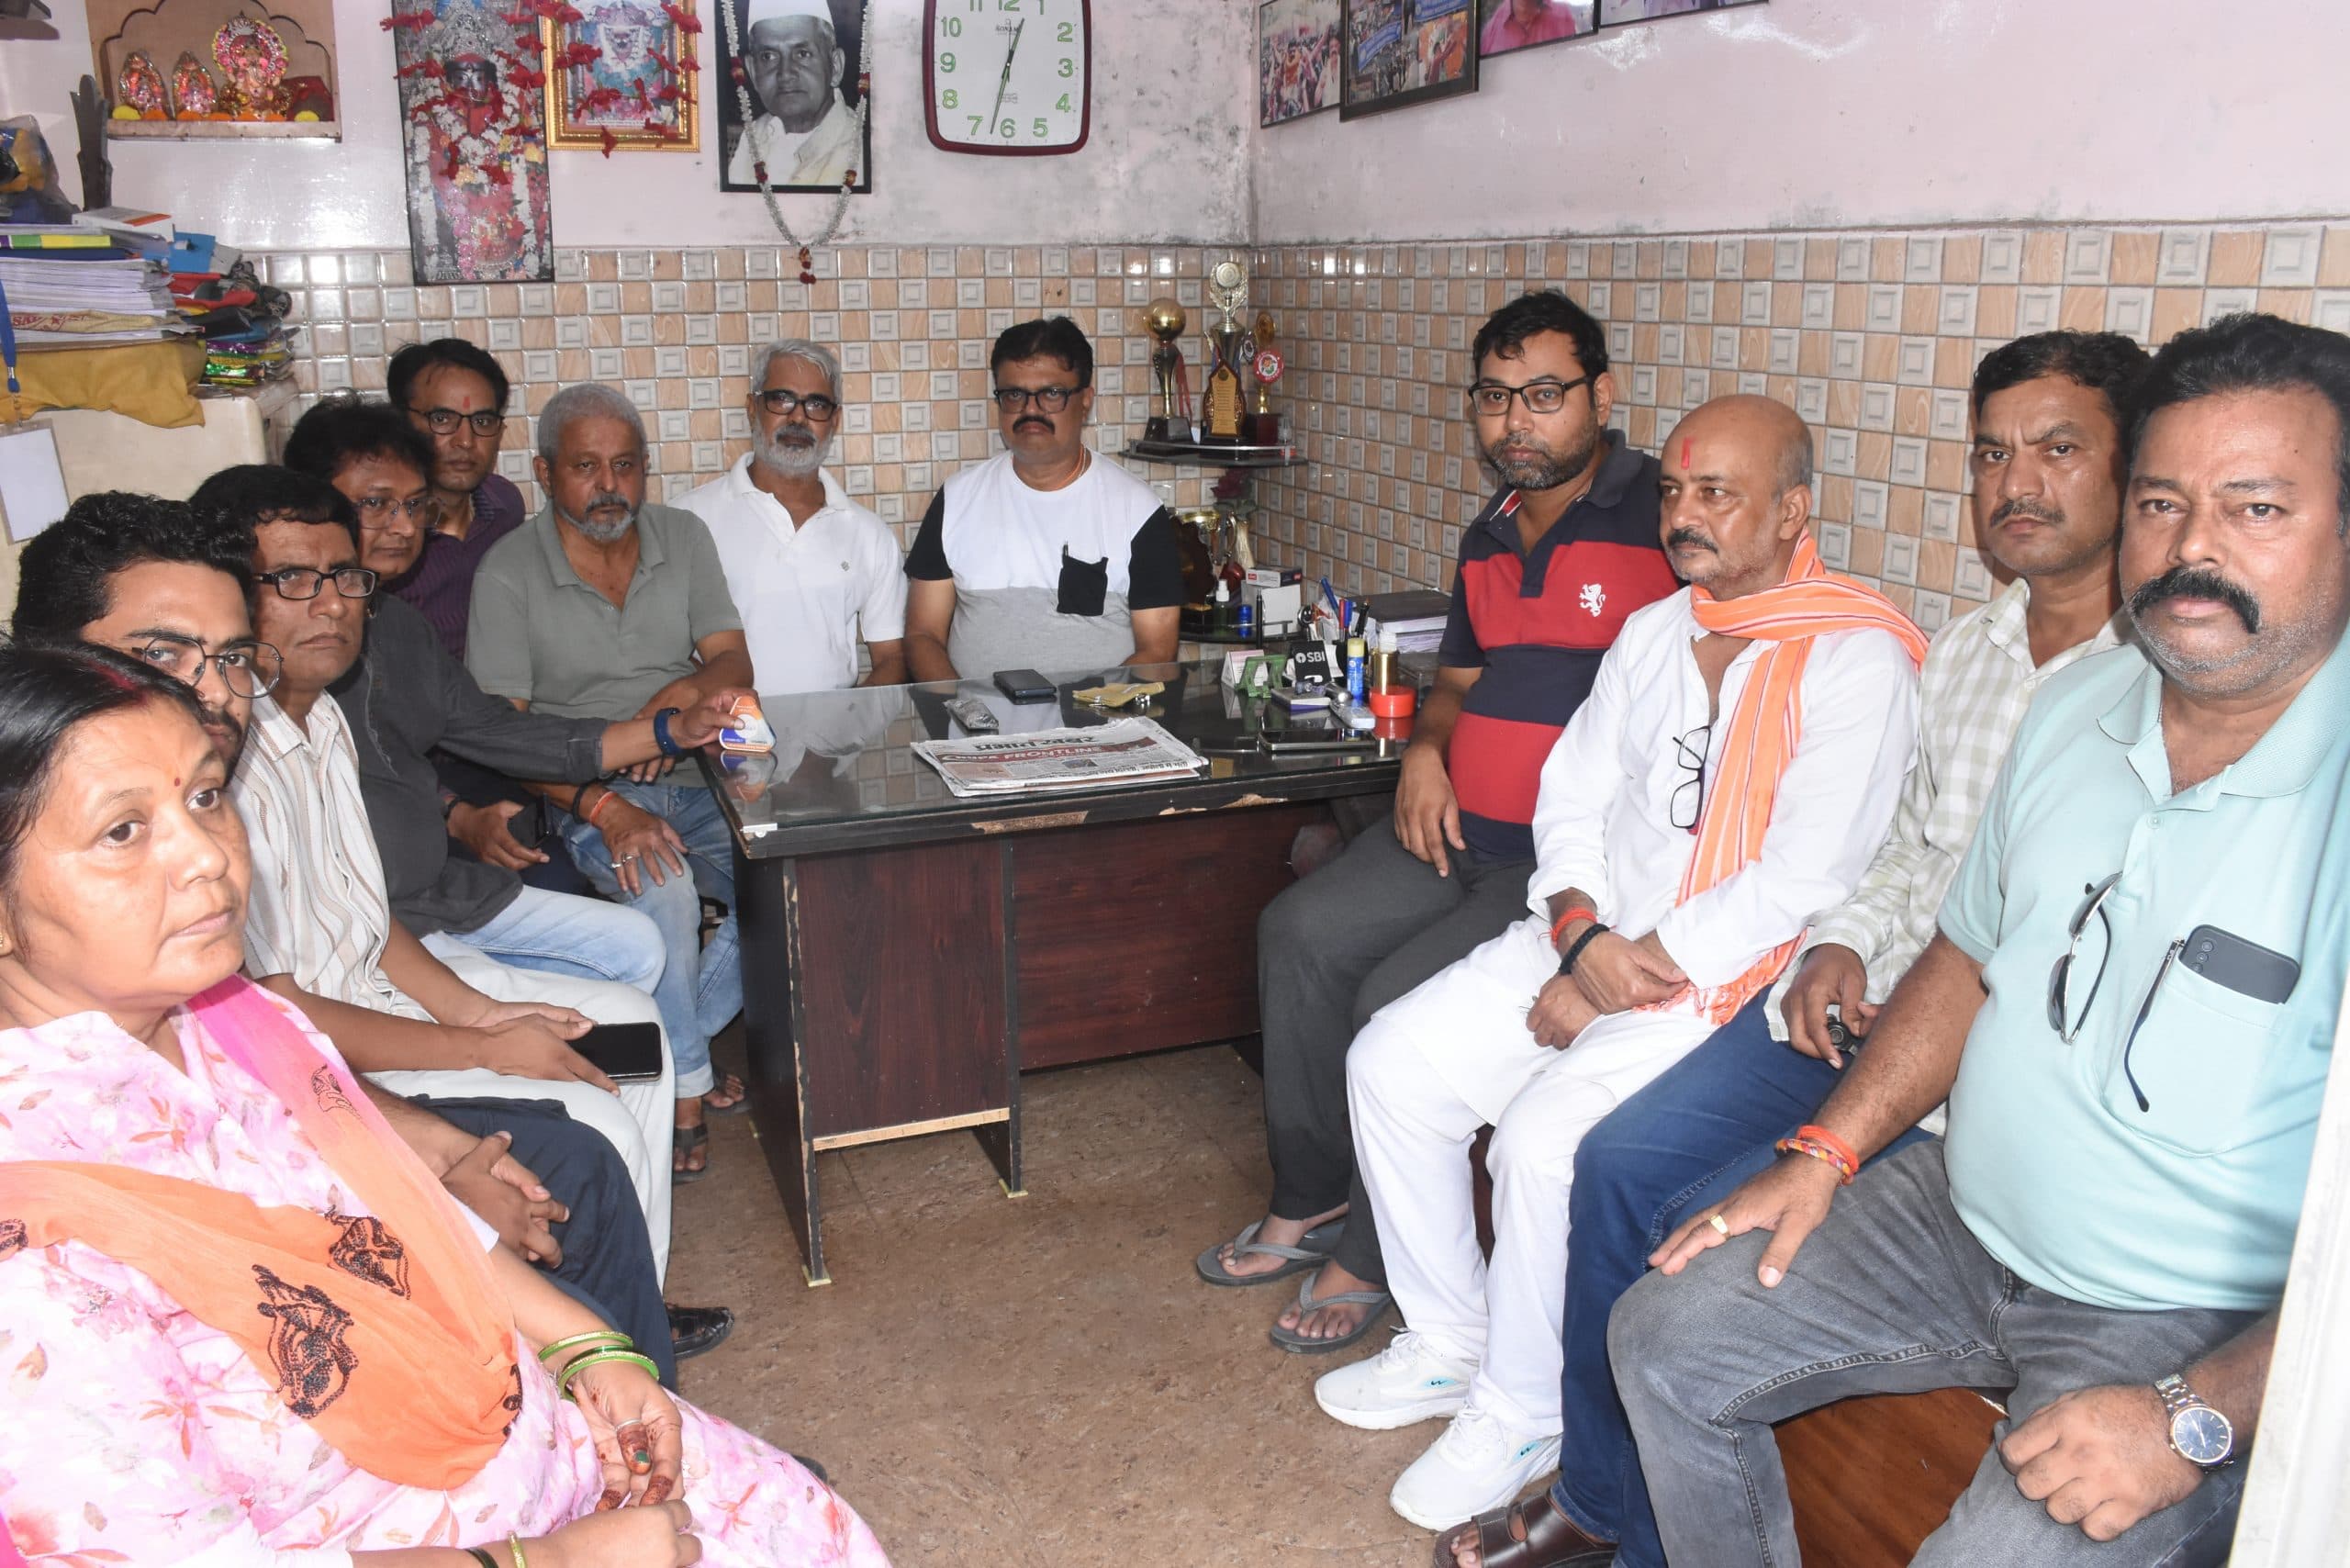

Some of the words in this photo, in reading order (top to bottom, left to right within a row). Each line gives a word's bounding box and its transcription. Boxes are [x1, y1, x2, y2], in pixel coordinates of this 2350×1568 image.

[941, 17, 962, 38] 10
[1057, 22, 1073, 42] 2
[940, 52, 957, 73] 9
[1058, 58, 1073, 78] 3
[942, 89, 958, 109] 8
[1056, 93, 1071, 113] 4
[967, 116, 983, 136] 7
[1000, 118, 1016, 139] 6
[1033, 118, 1048, 138] 5
[1306, 651, 1326, 663] SBI
